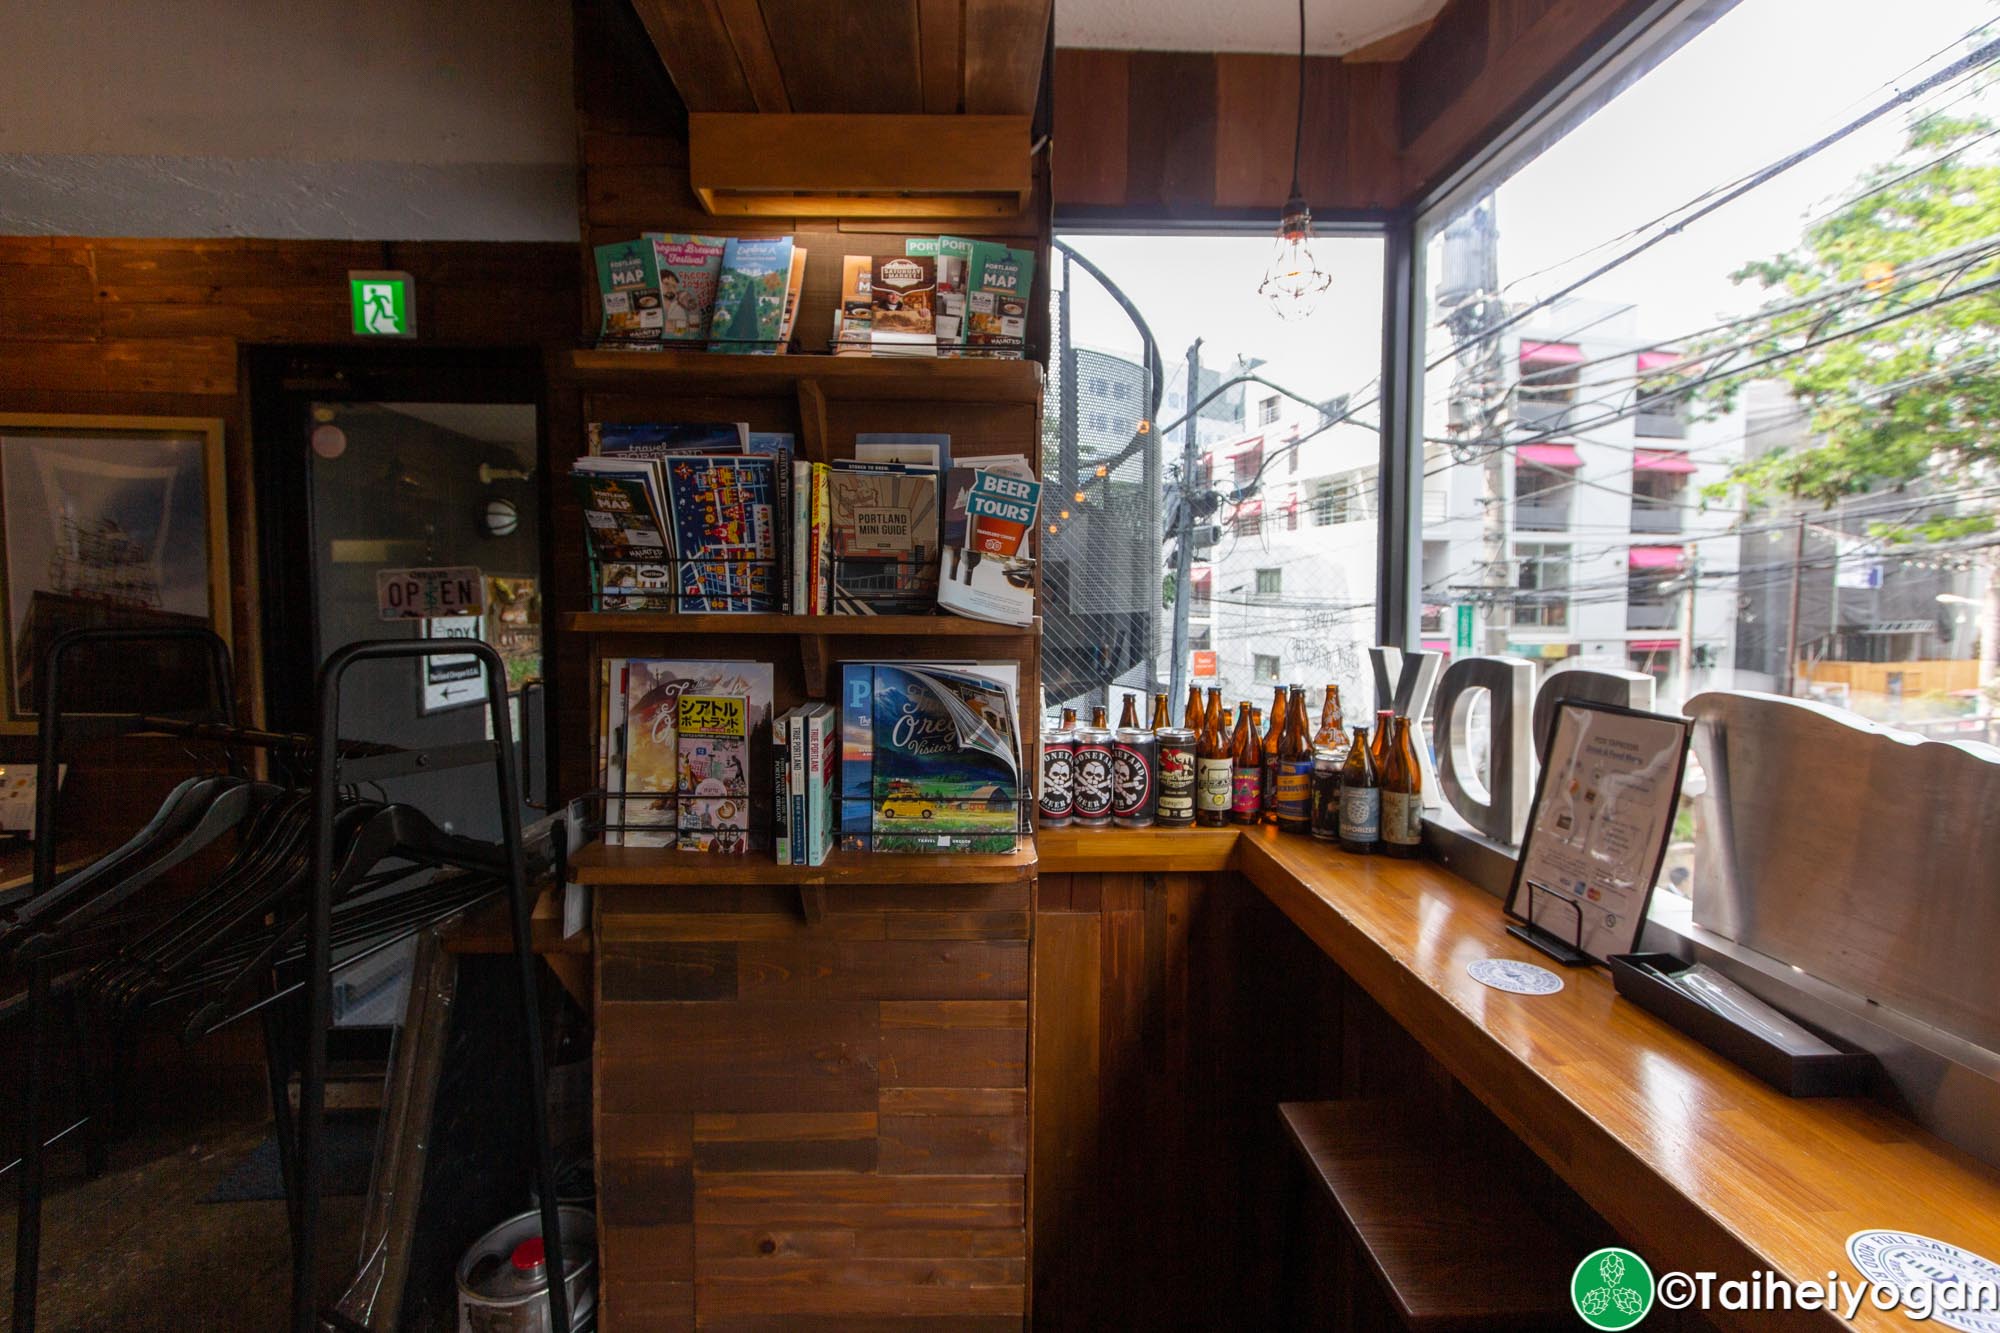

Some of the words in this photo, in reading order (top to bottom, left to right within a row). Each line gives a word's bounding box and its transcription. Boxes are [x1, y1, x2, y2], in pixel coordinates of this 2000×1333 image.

[612, 270, 644, 285] MAP
[983, 273, 1017, 288] MAP
[983, 475, 1031, 499] BEER
[597, 499, 631, 510] MAP
[974, 497, 1030, 522] TOURS
[858, 513, 907, 524] PORTLAND
[859, 525, 879, 535] MINI
[881, 525, 907, 535] GUIDE
[388, 580, 473, 607] OPEN
[681, 699, 738, 717] シアトル
[793, 727, 801, 743] TRUE
[810, 728, 818, 742] TRUE
[907, 739, 954, 755] Visitor
[793, 744, 802, 771] PORTLAND
[810, 743, 819, 772] PORTLAND
[1043, 796, 1066, 808] BEER
[1077, 795, 1100, 808] BEER
[1870, 1234, 1914, 1246] FULL
[1915, 1239, 1960, 1257] SAIL
[1858, 1242, 1878, 1269] HOOD
